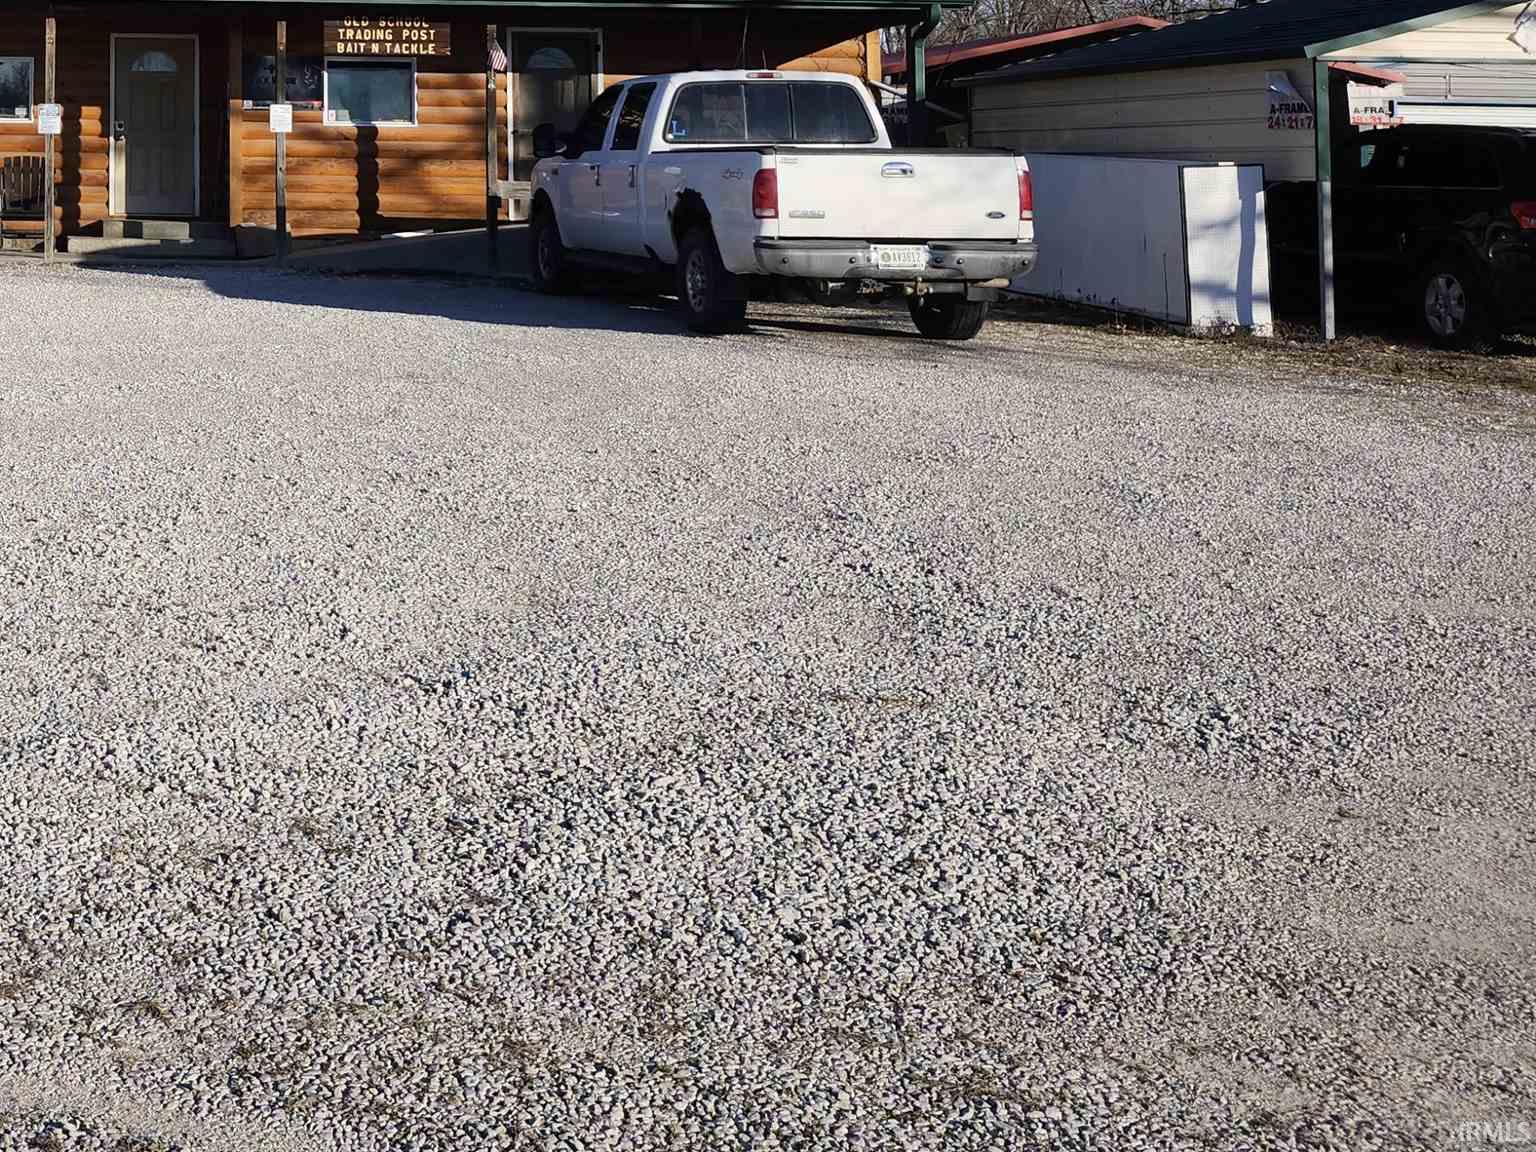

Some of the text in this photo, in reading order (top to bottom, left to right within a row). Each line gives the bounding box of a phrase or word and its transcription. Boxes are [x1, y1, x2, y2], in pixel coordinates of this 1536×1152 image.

[343, 16, 430, 27] OLD SCHOOL
[337, 29, 436, 41] TRADING POST
[336, 42, 436, 55] BAIT N TACKLE
